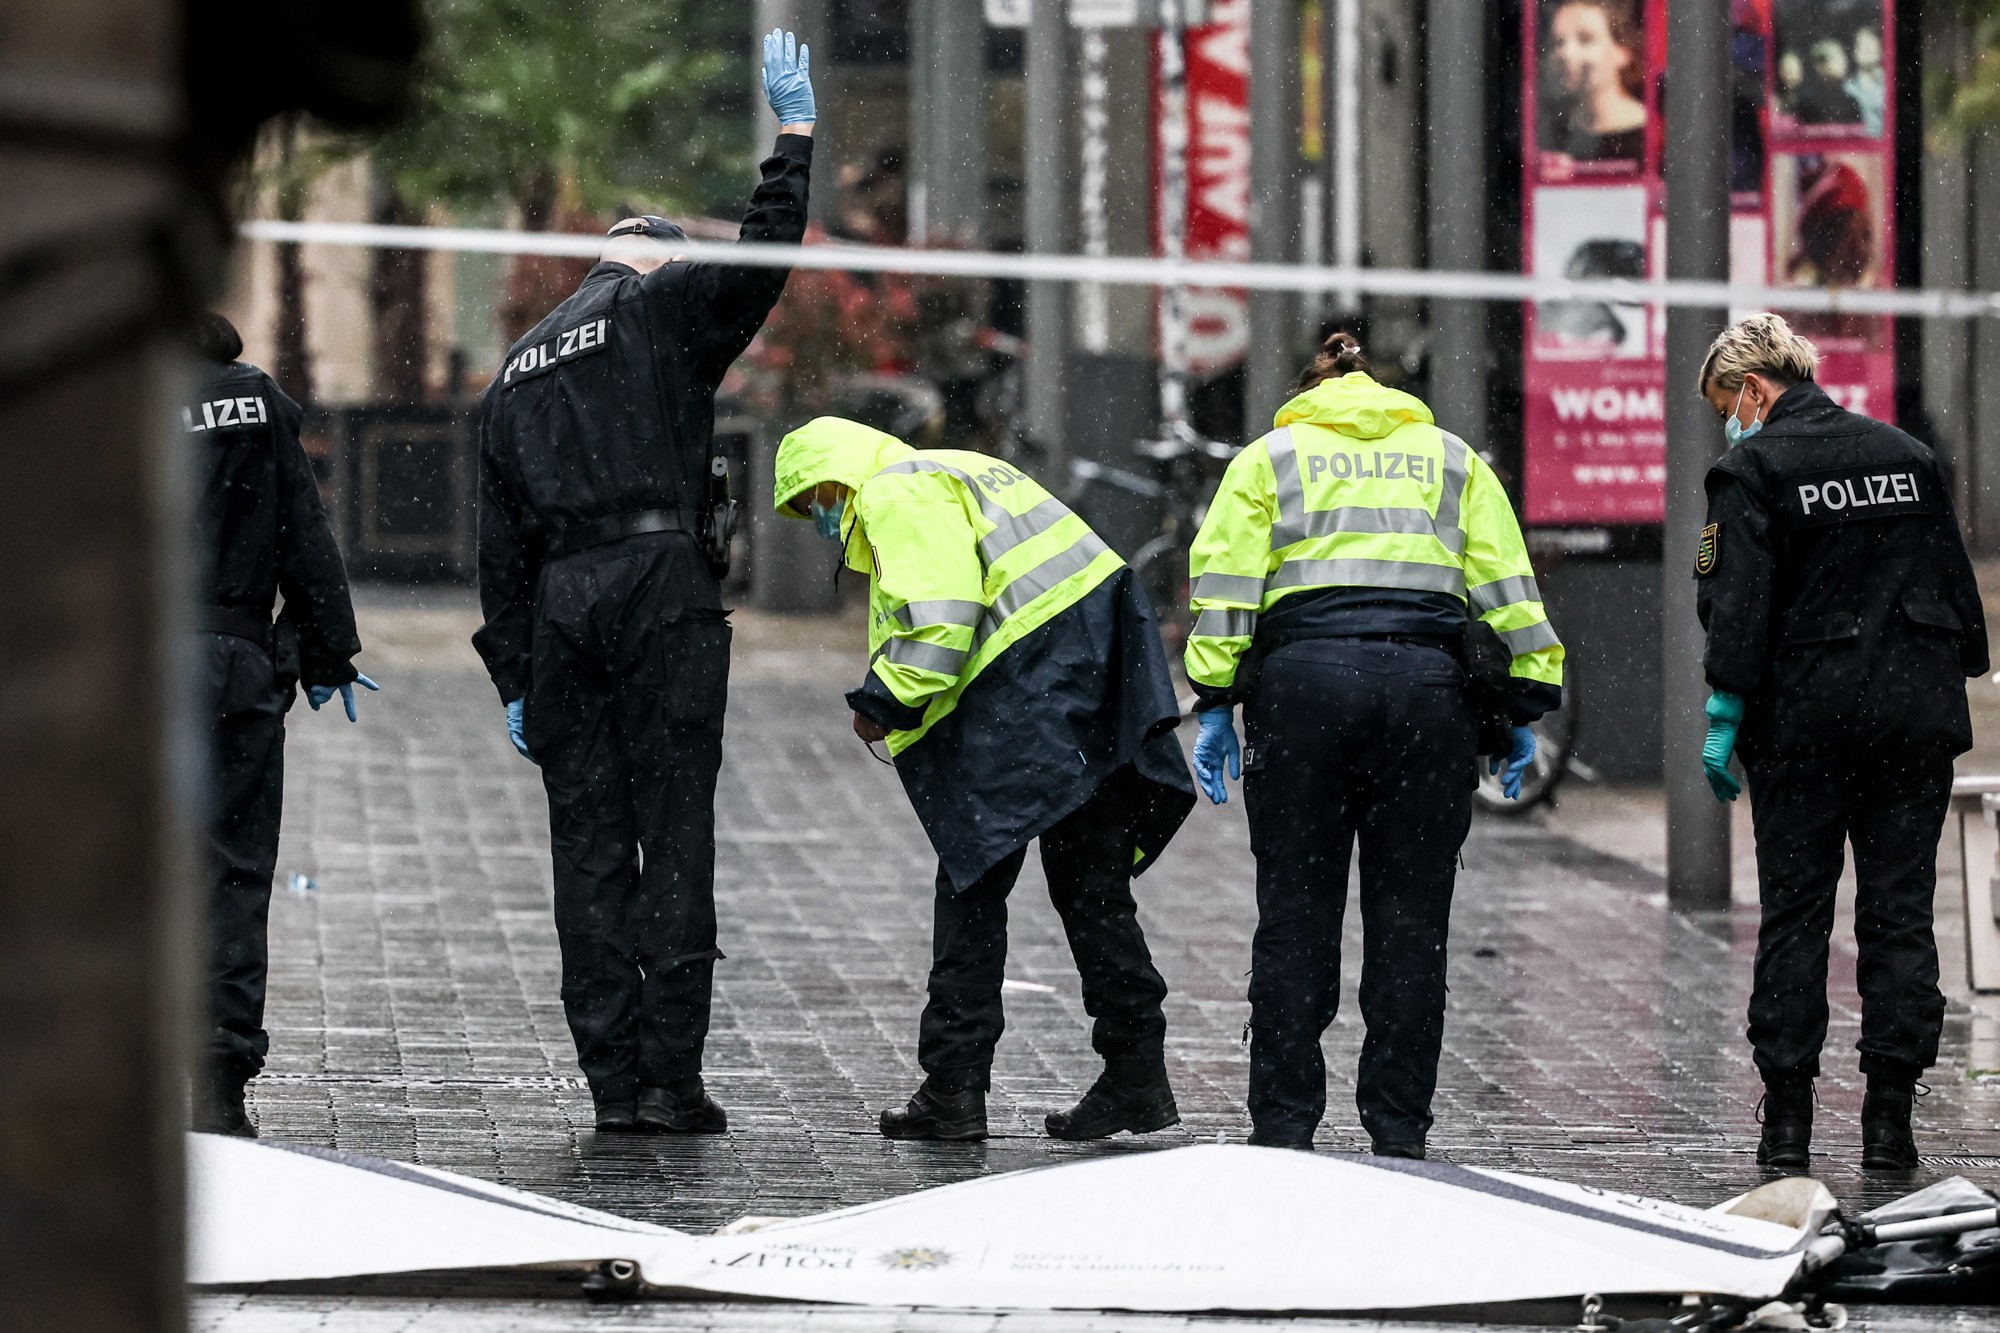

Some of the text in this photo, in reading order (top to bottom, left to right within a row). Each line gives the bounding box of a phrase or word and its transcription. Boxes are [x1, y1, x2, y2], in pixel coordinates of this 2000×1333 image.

[503, 319, 606, 384] POLIZEI
[181, 397, 267, 432] LIZEI
[975, 464, 1027, 493] POL
[1307, 451, 1434, 484] POLIZEI
[1798, 473, 1920, 515] POLIZEI
[710, 1252, 853, 1269] POLIZ
